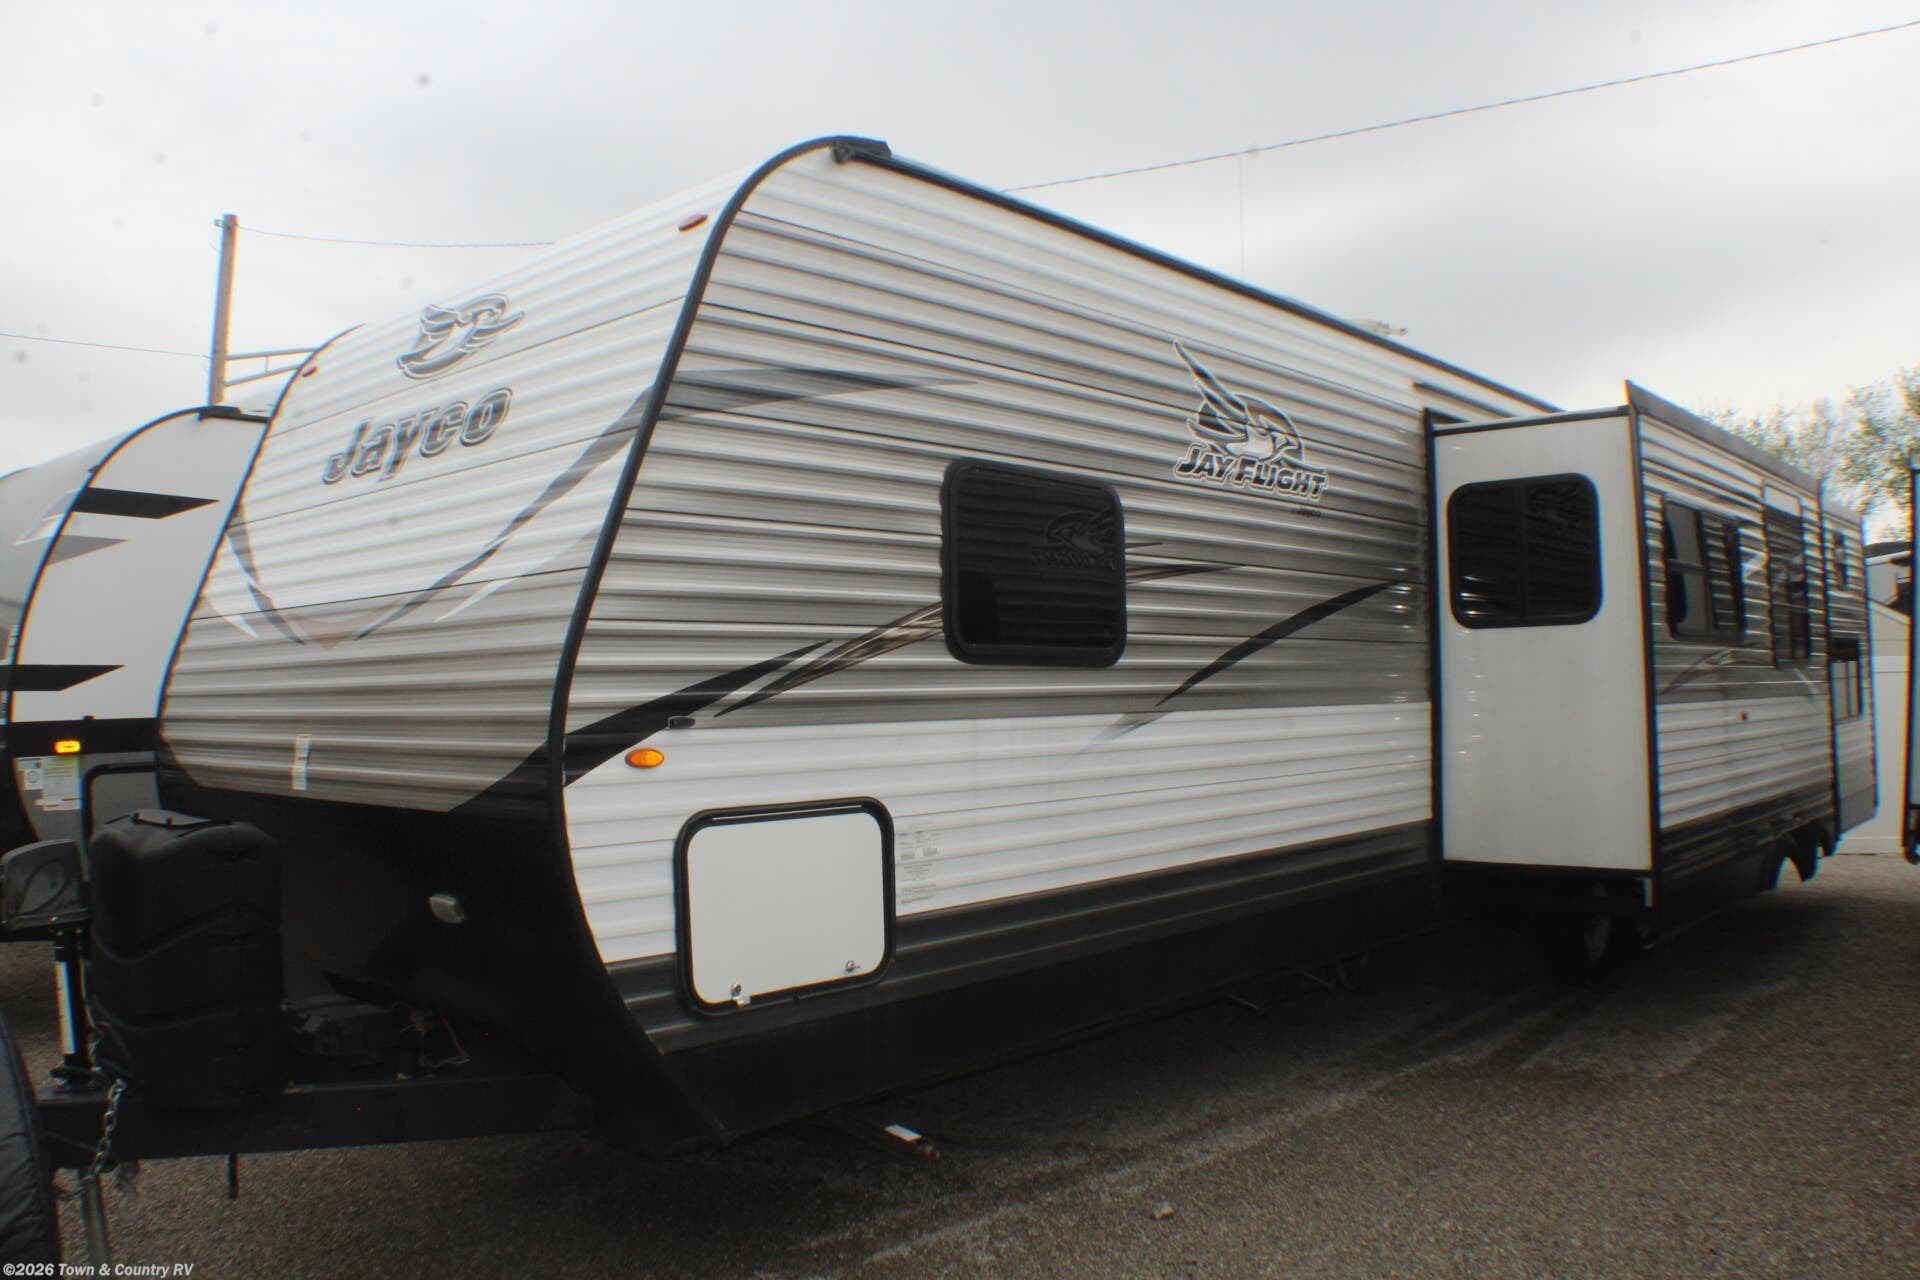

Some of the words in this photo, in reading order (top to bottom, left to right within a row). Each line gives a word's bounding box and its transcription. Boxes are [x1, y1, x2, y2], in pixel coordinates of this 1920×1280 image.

[322, 387, 513, 484] Jayco
[1174, 445, 1235, 482] JAY
[1232, 456, 1327, 498] FLIGHT
